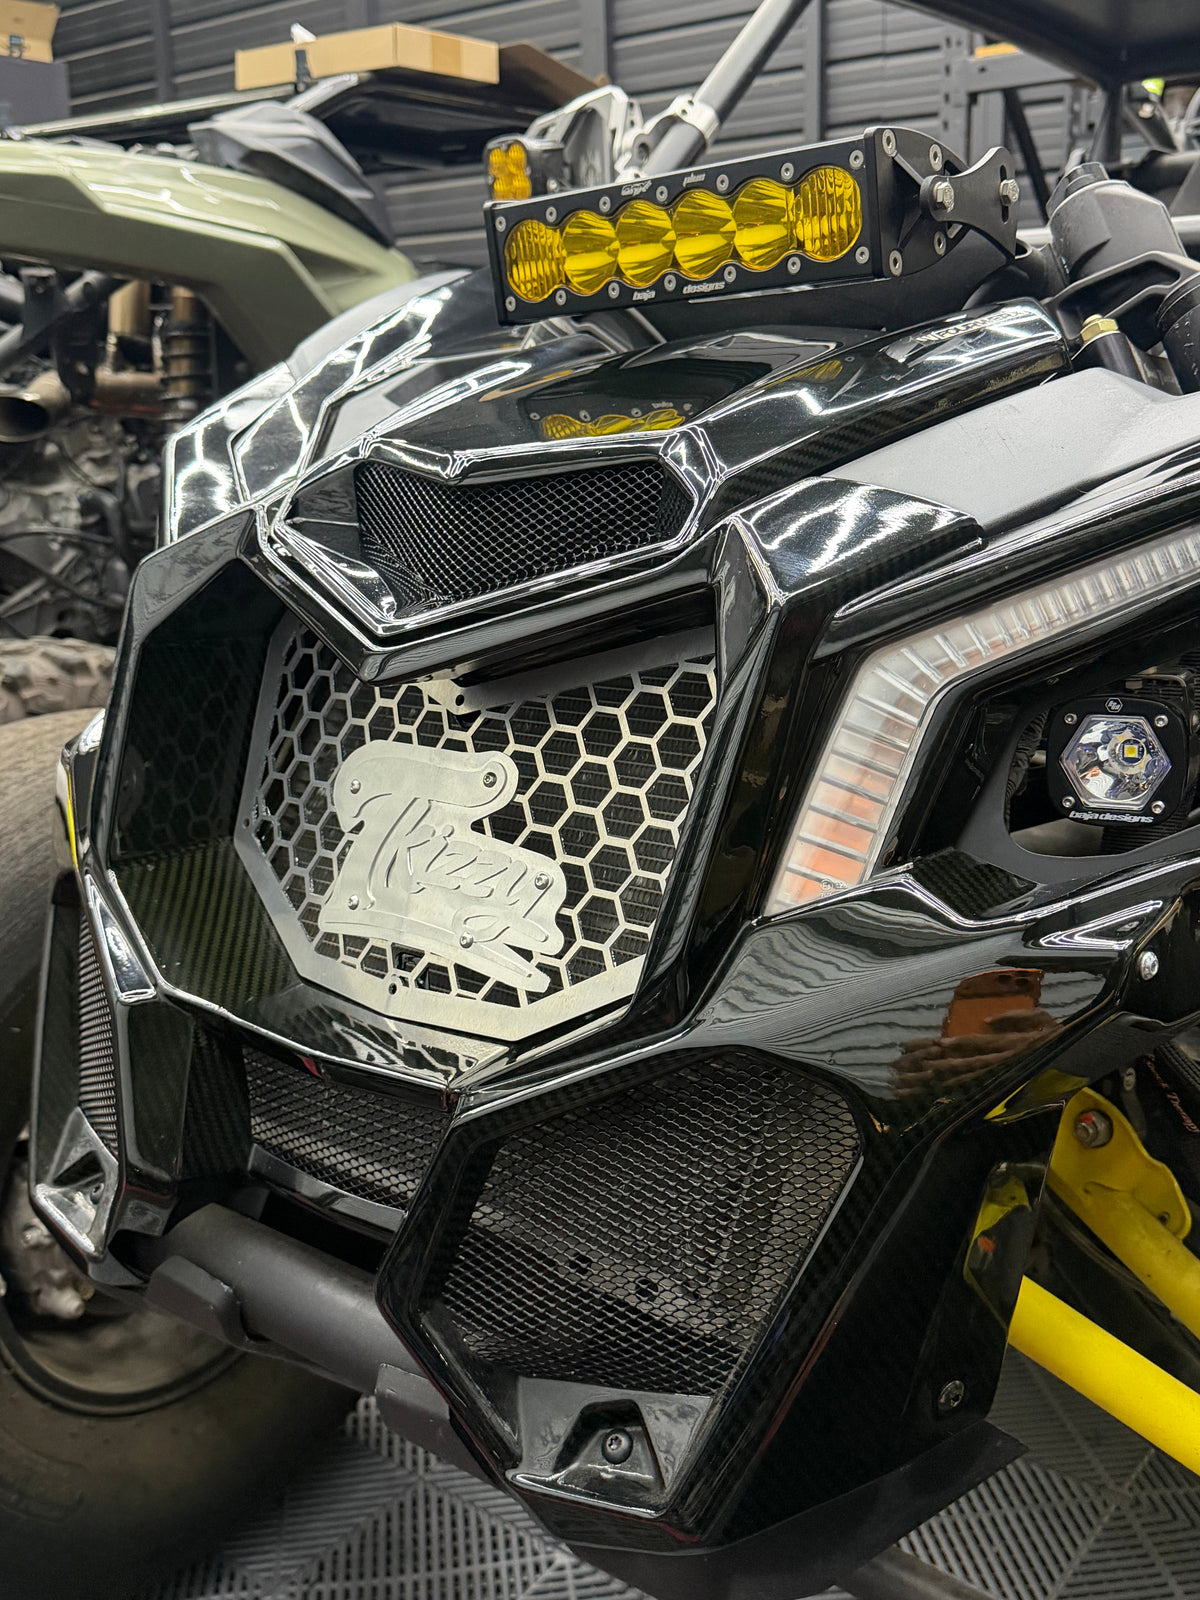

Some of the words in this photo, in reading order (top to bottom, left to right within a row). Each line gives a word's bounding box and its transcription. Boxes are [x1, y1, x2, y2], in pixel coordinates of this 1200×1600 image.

[632, 289, 656, 301] baja
[682, 281, 726, 295] designs
[1069, 810, 1099, 821] baja
[1098, 812, 1154, 824] designs
